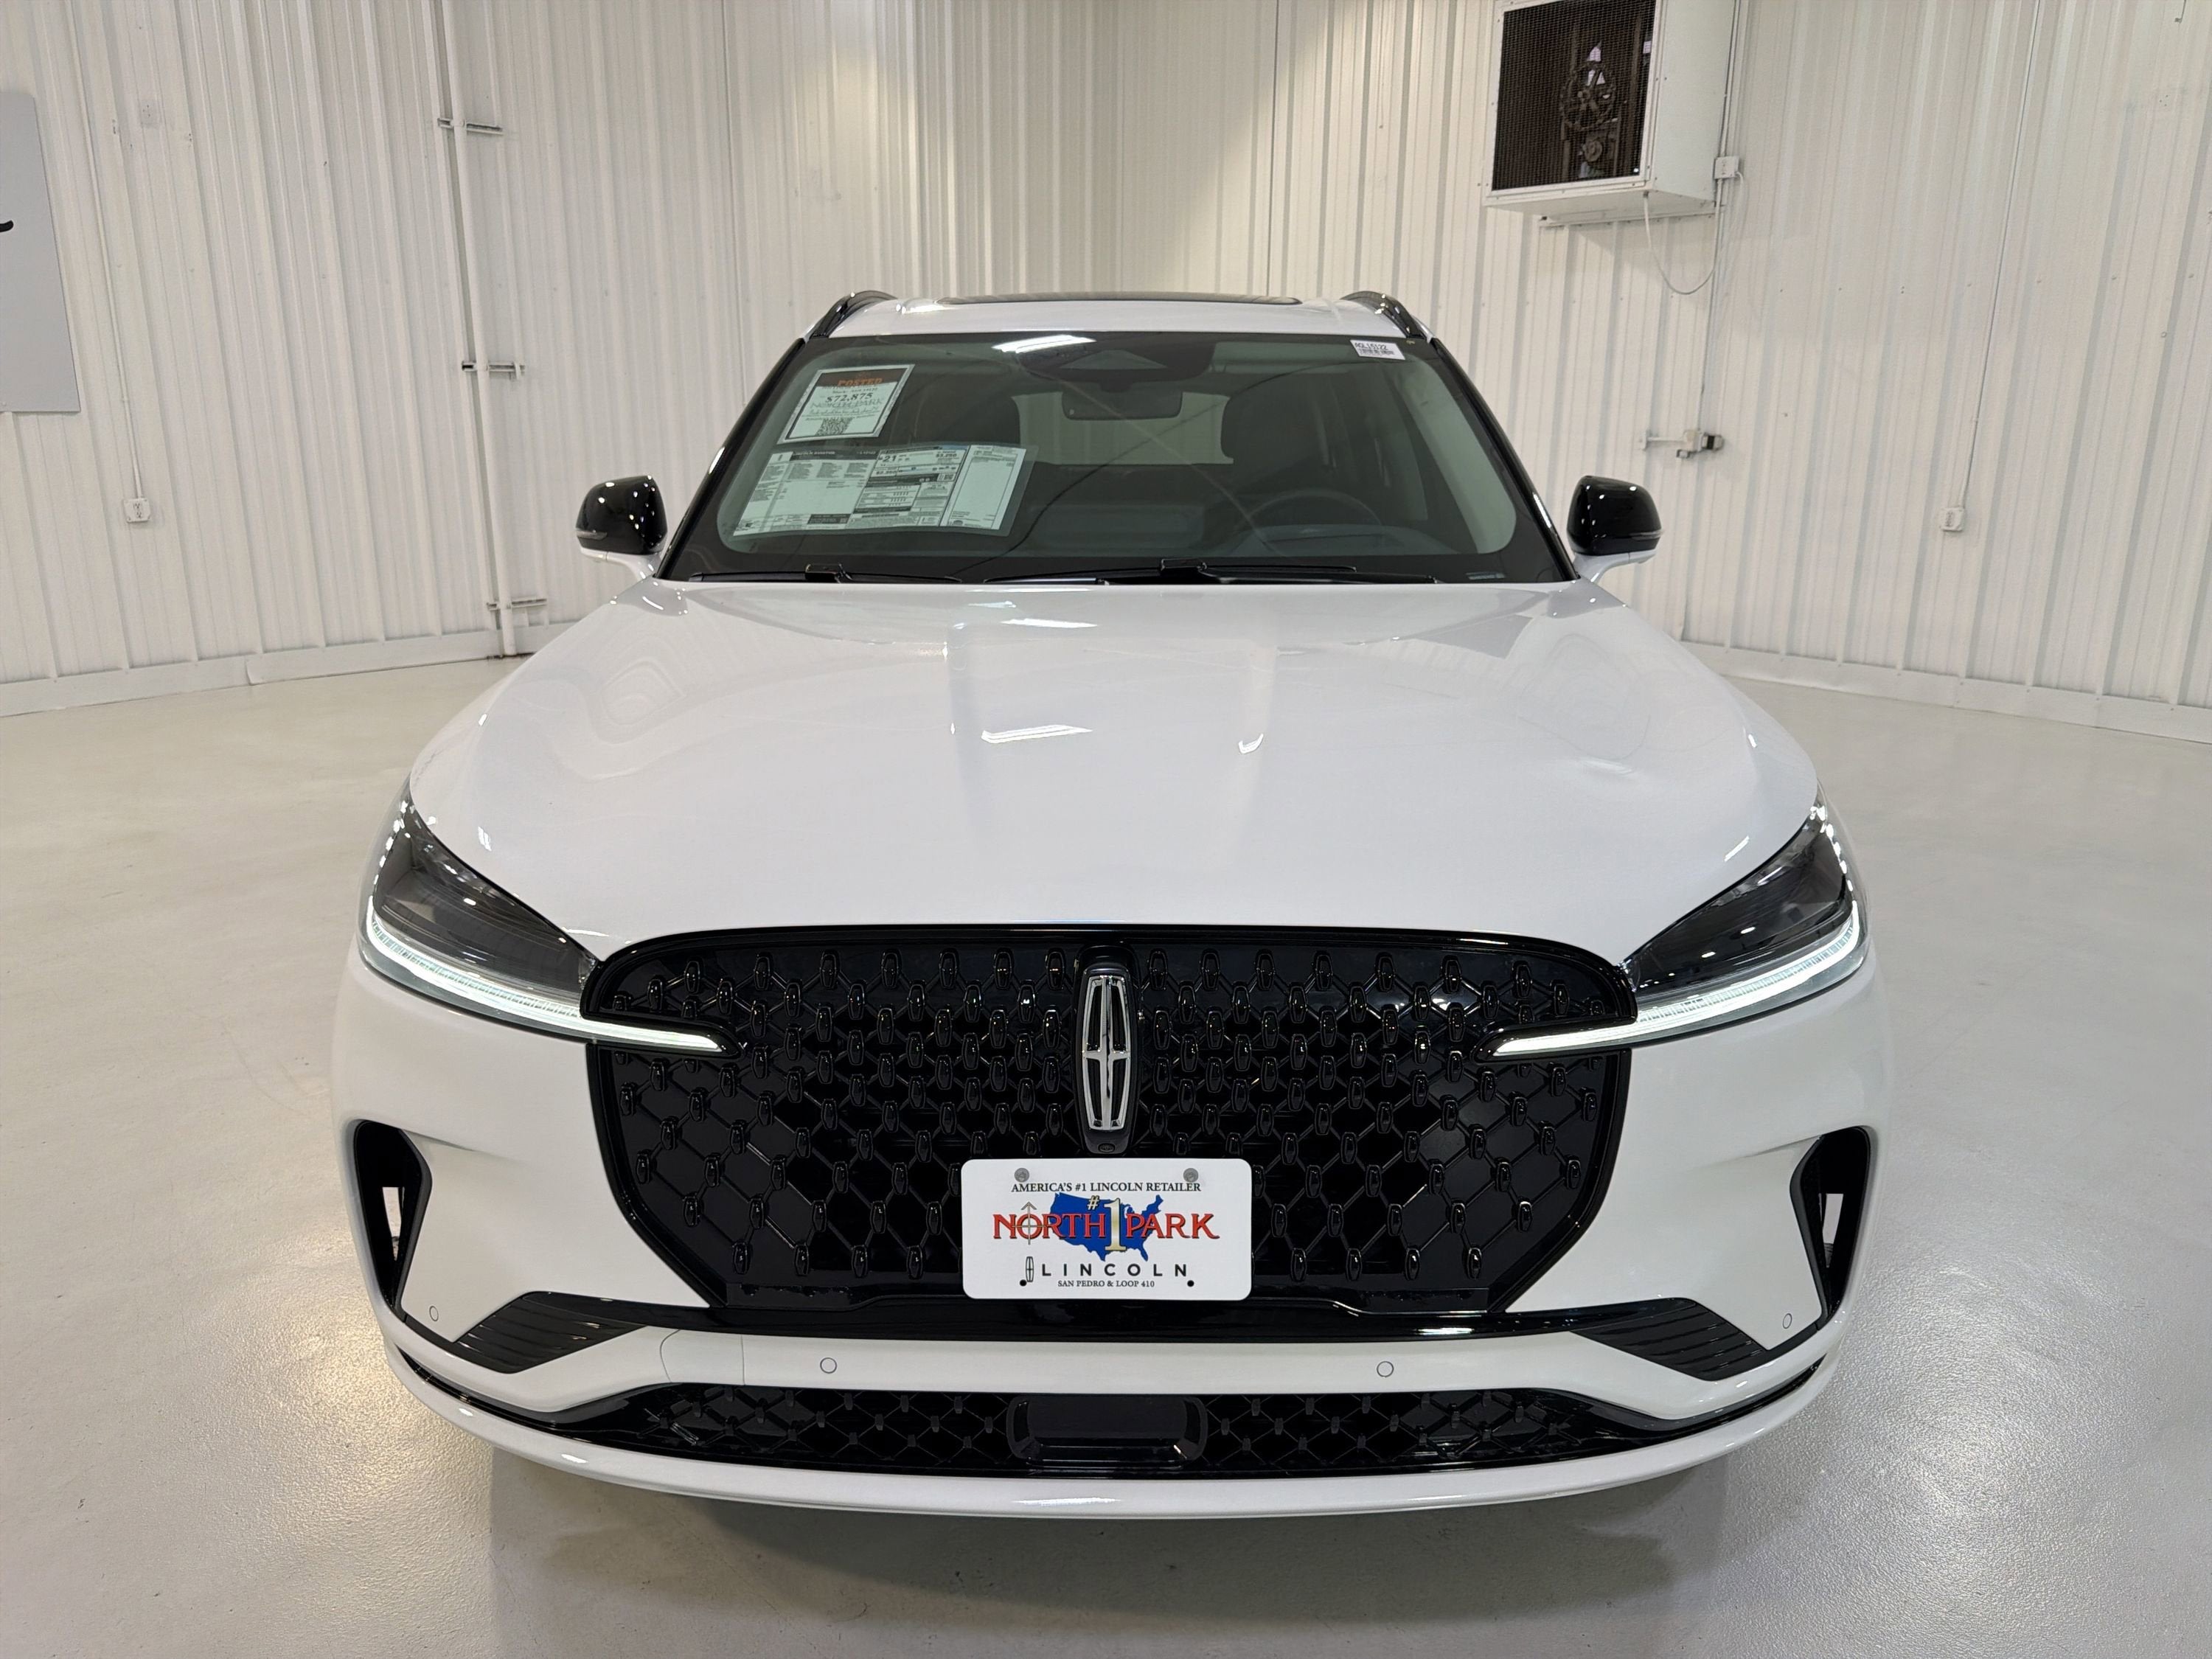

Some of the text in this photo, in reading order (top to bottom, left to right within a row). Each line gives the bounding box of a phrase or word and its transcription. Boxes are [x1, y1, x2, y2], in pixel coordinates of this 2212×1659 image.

[837, 378, 883, 386] POSTED
[825, 392, 874, 403] $72,875
[882, 455, 897, 463] 21
[1011, 1181, 1201, 1192] AMERICA'S #1 LINCOLN RETAILER
[993, 1213, 1220, 1239] NORTH PARK
[1042, 1263, 1187, 1277] LINCOLN
